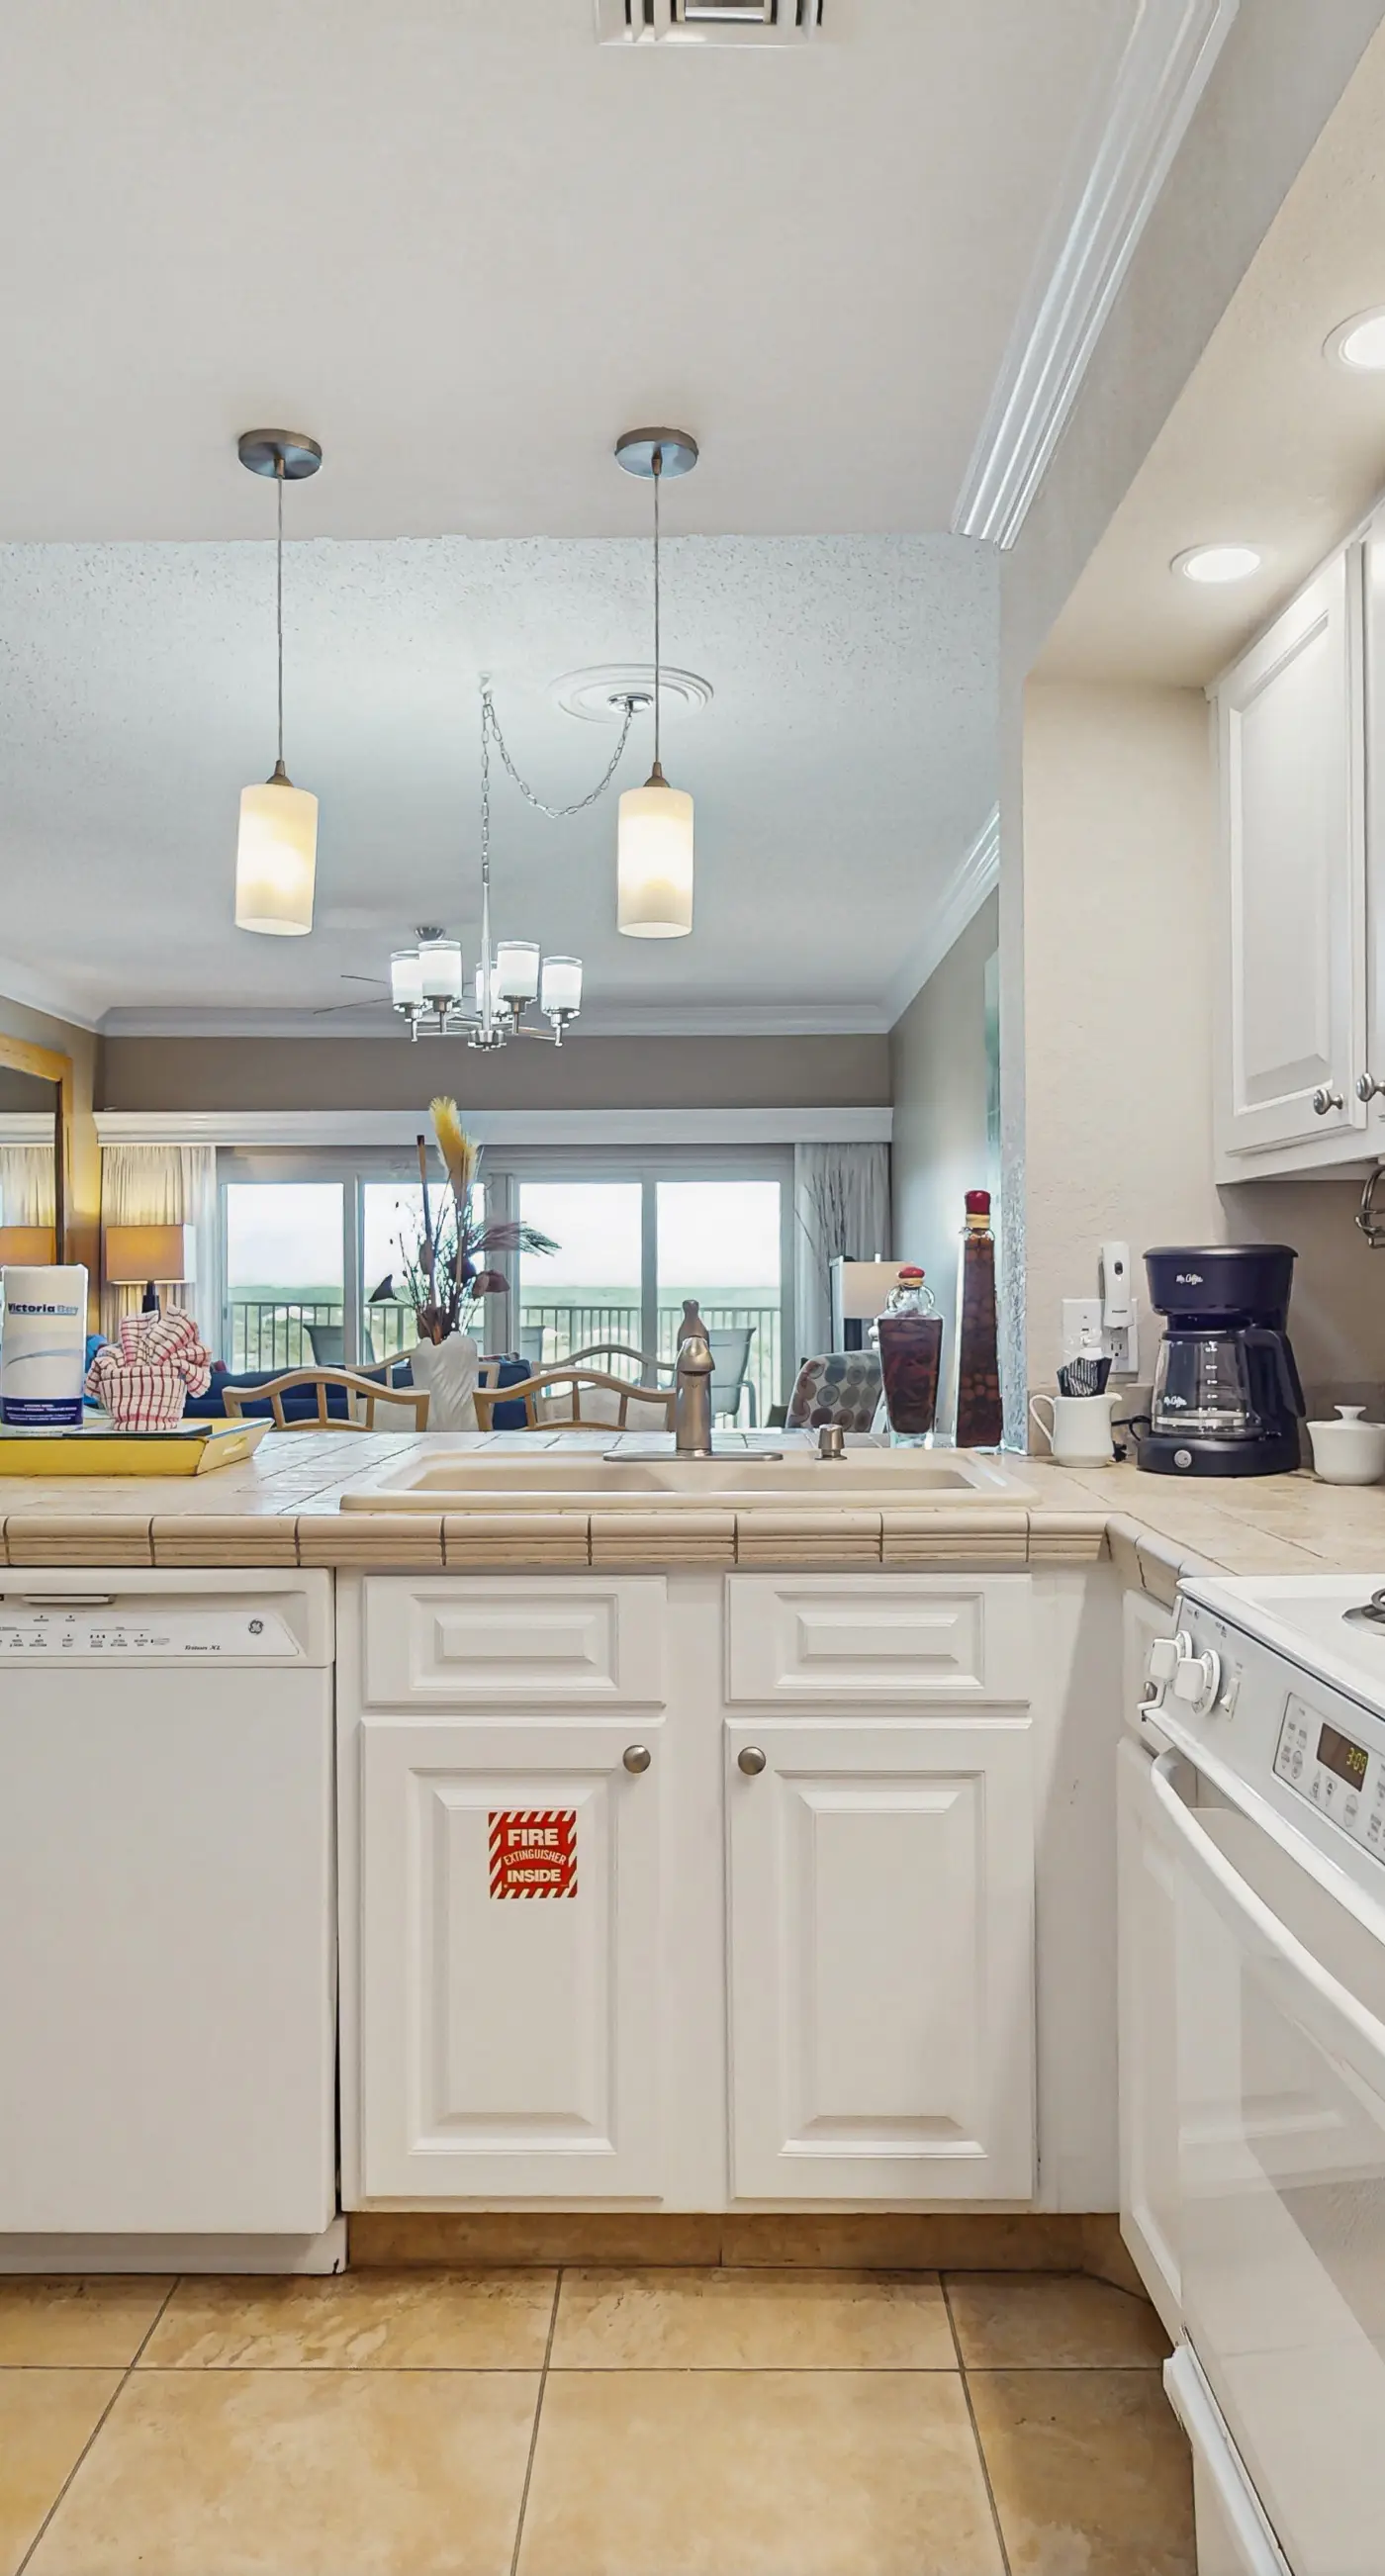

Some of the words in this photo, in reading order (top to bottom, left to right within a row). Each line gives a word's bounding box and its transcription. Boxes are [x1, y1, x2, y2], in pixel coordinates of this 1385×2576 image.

[8, 1303, 55, 1314] Victoria
[1345, 1747, 1367, 1775] 3:09
[508, 1828, 560, 1846] FIRE
[503, 1848, 567, 1866] EXTINGUISHER
[507, 1869, 561, 1883] INSIDE
